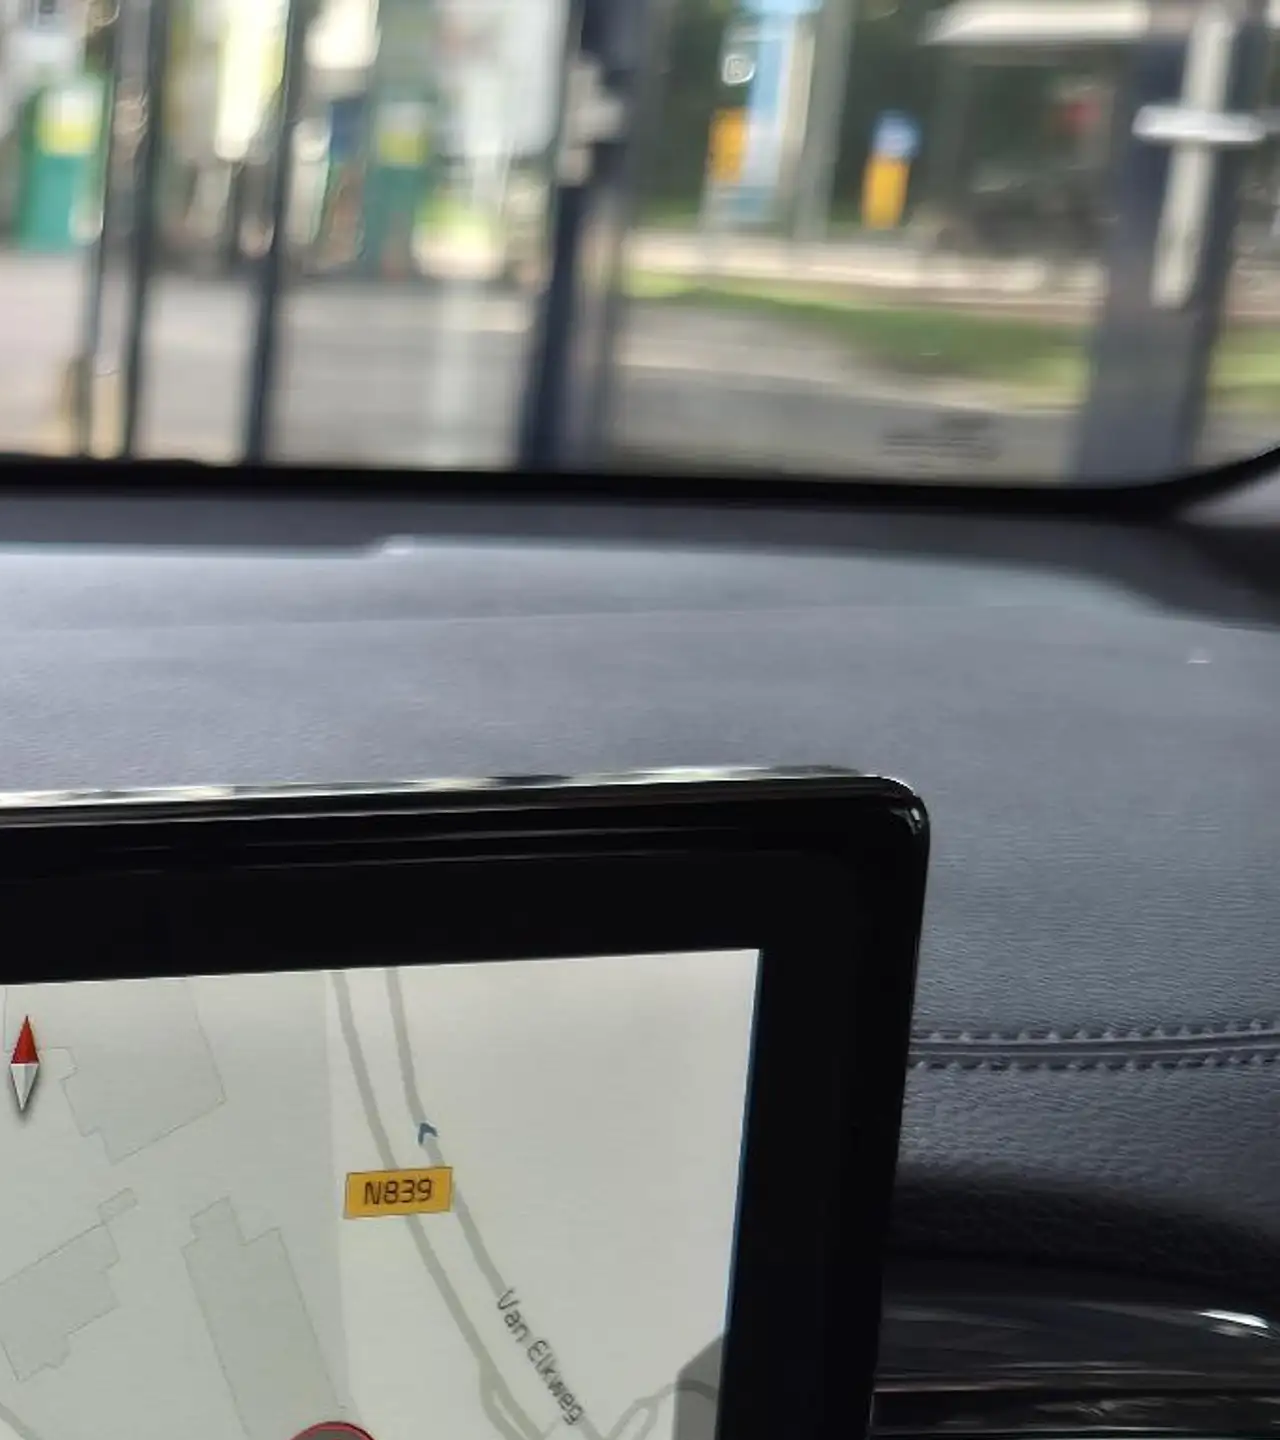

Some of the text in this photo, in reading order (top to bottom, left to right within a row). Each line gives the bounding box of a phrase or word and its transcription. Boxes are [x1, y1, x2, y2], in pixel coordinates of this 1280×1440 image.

[363, 1178, 433, 1206] N839
[497, 1289, 584, 1425] Van Elkweg
